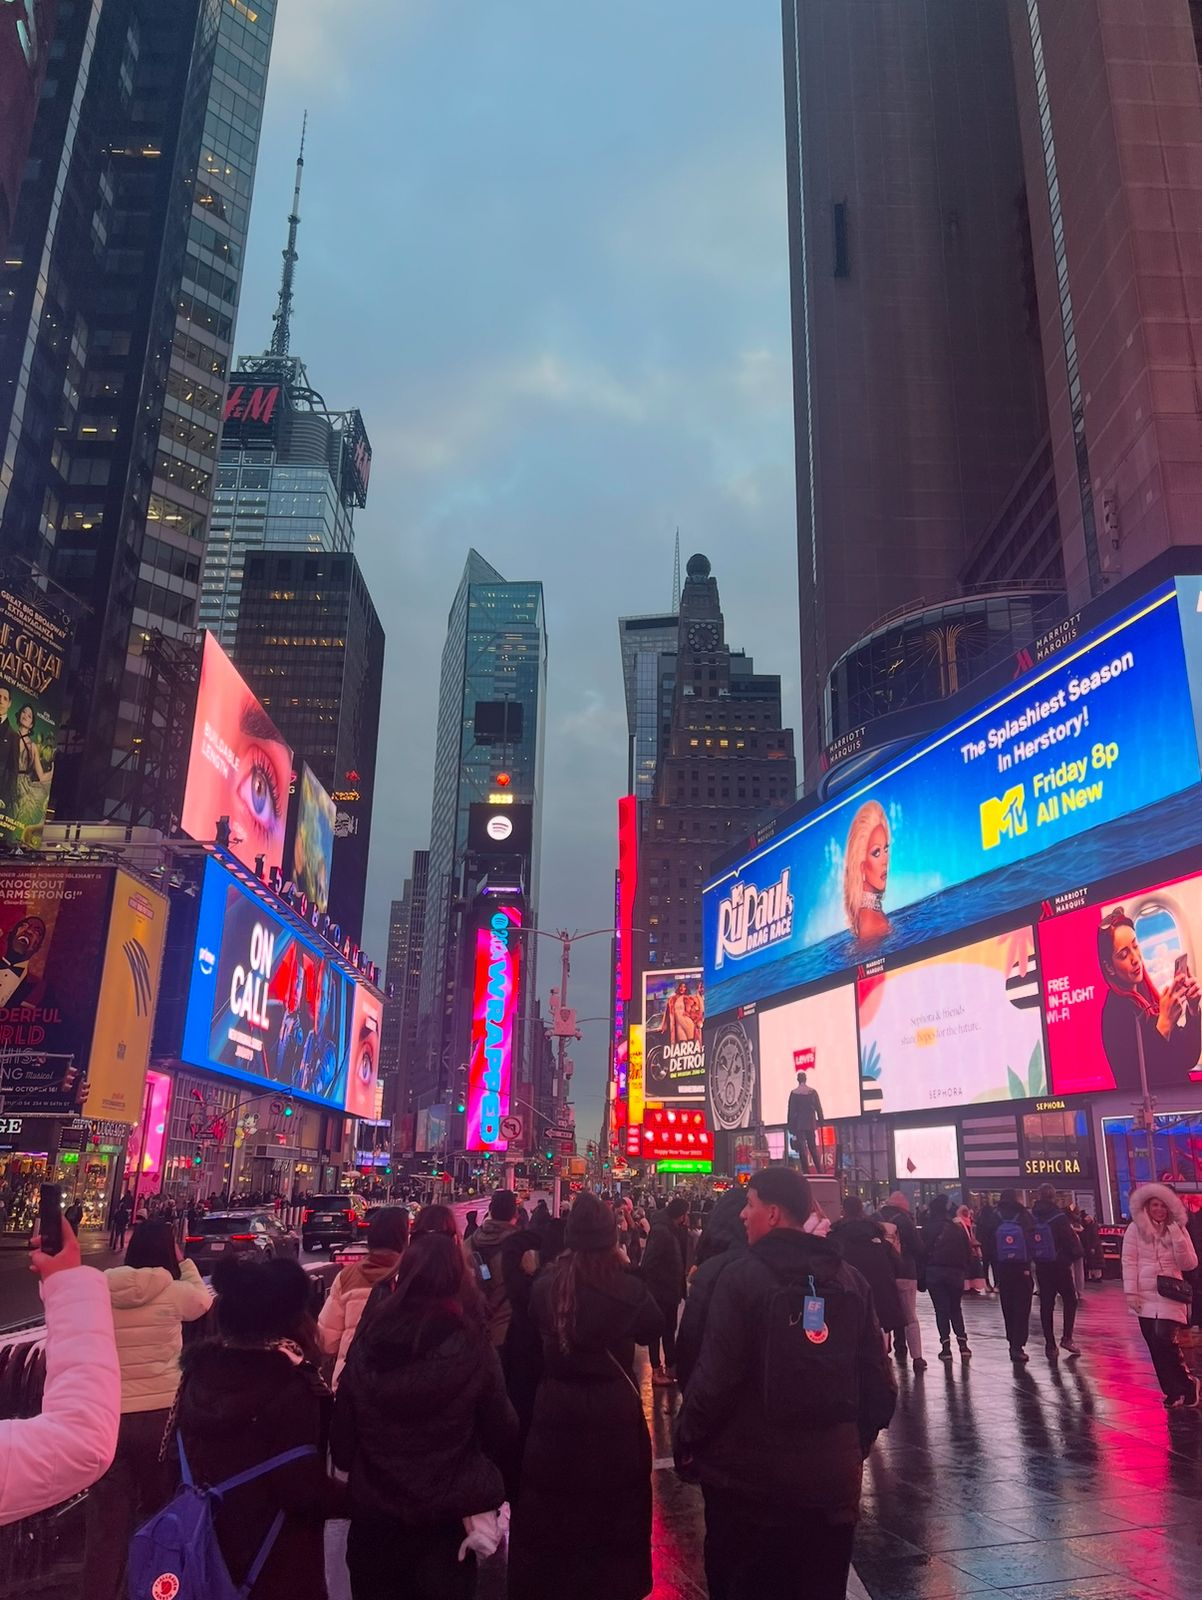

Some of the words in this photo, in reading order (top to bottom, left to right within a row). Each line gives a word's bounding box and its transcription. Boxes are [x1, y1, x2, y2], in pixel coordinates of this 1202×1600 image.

[8, 603, 54, 640] EXTRAVAGANZA
[34, 612, 66, 638] BROADWAY
[1036, 612, 1081, 649] MARRIOTT
[1037, 628, 1077, 660] MARQUIS
[960, 739, 986, 764] The
[987, 688, 1067, 750] Splashiest
[1068, 651, 1135, 702] Season
[829, 727, 866, 754] MARRIOTT
[829, 740, 861, 763] MARQUIS
[998, 751, 1013, 773] In
[1013, 705, 1090, 765] Herstory!
[1033, 756, 1088, 798] Friday
[1091, 742, 1119, 769] 8p
[980, 783, 1028, 851] MTV
[1037, 796, 1060, 827] All
[1061, 780, 1104, 815] New
[1055, 888, 1087, 904] MARRIOTT
[1056, 897, 1085, 912] MARQUIS
[747, 929, 768, 951] DRAG
[770, 916, 792, 941] RACE
[250, 922, 274, 979] ON
[230, 964, 270, 1030] CALL
[1047, 976, 1070, 993] FREE
[480, 960, 507, 1144] WRAPPED
[663, 1040, 700, 1060] DIARRA
[25, 1071, 53, 1080] Musical
[929, 1087, 963, 1099] SEPHORA
[1036, 1101, 1065, 1111] SEPHORA
